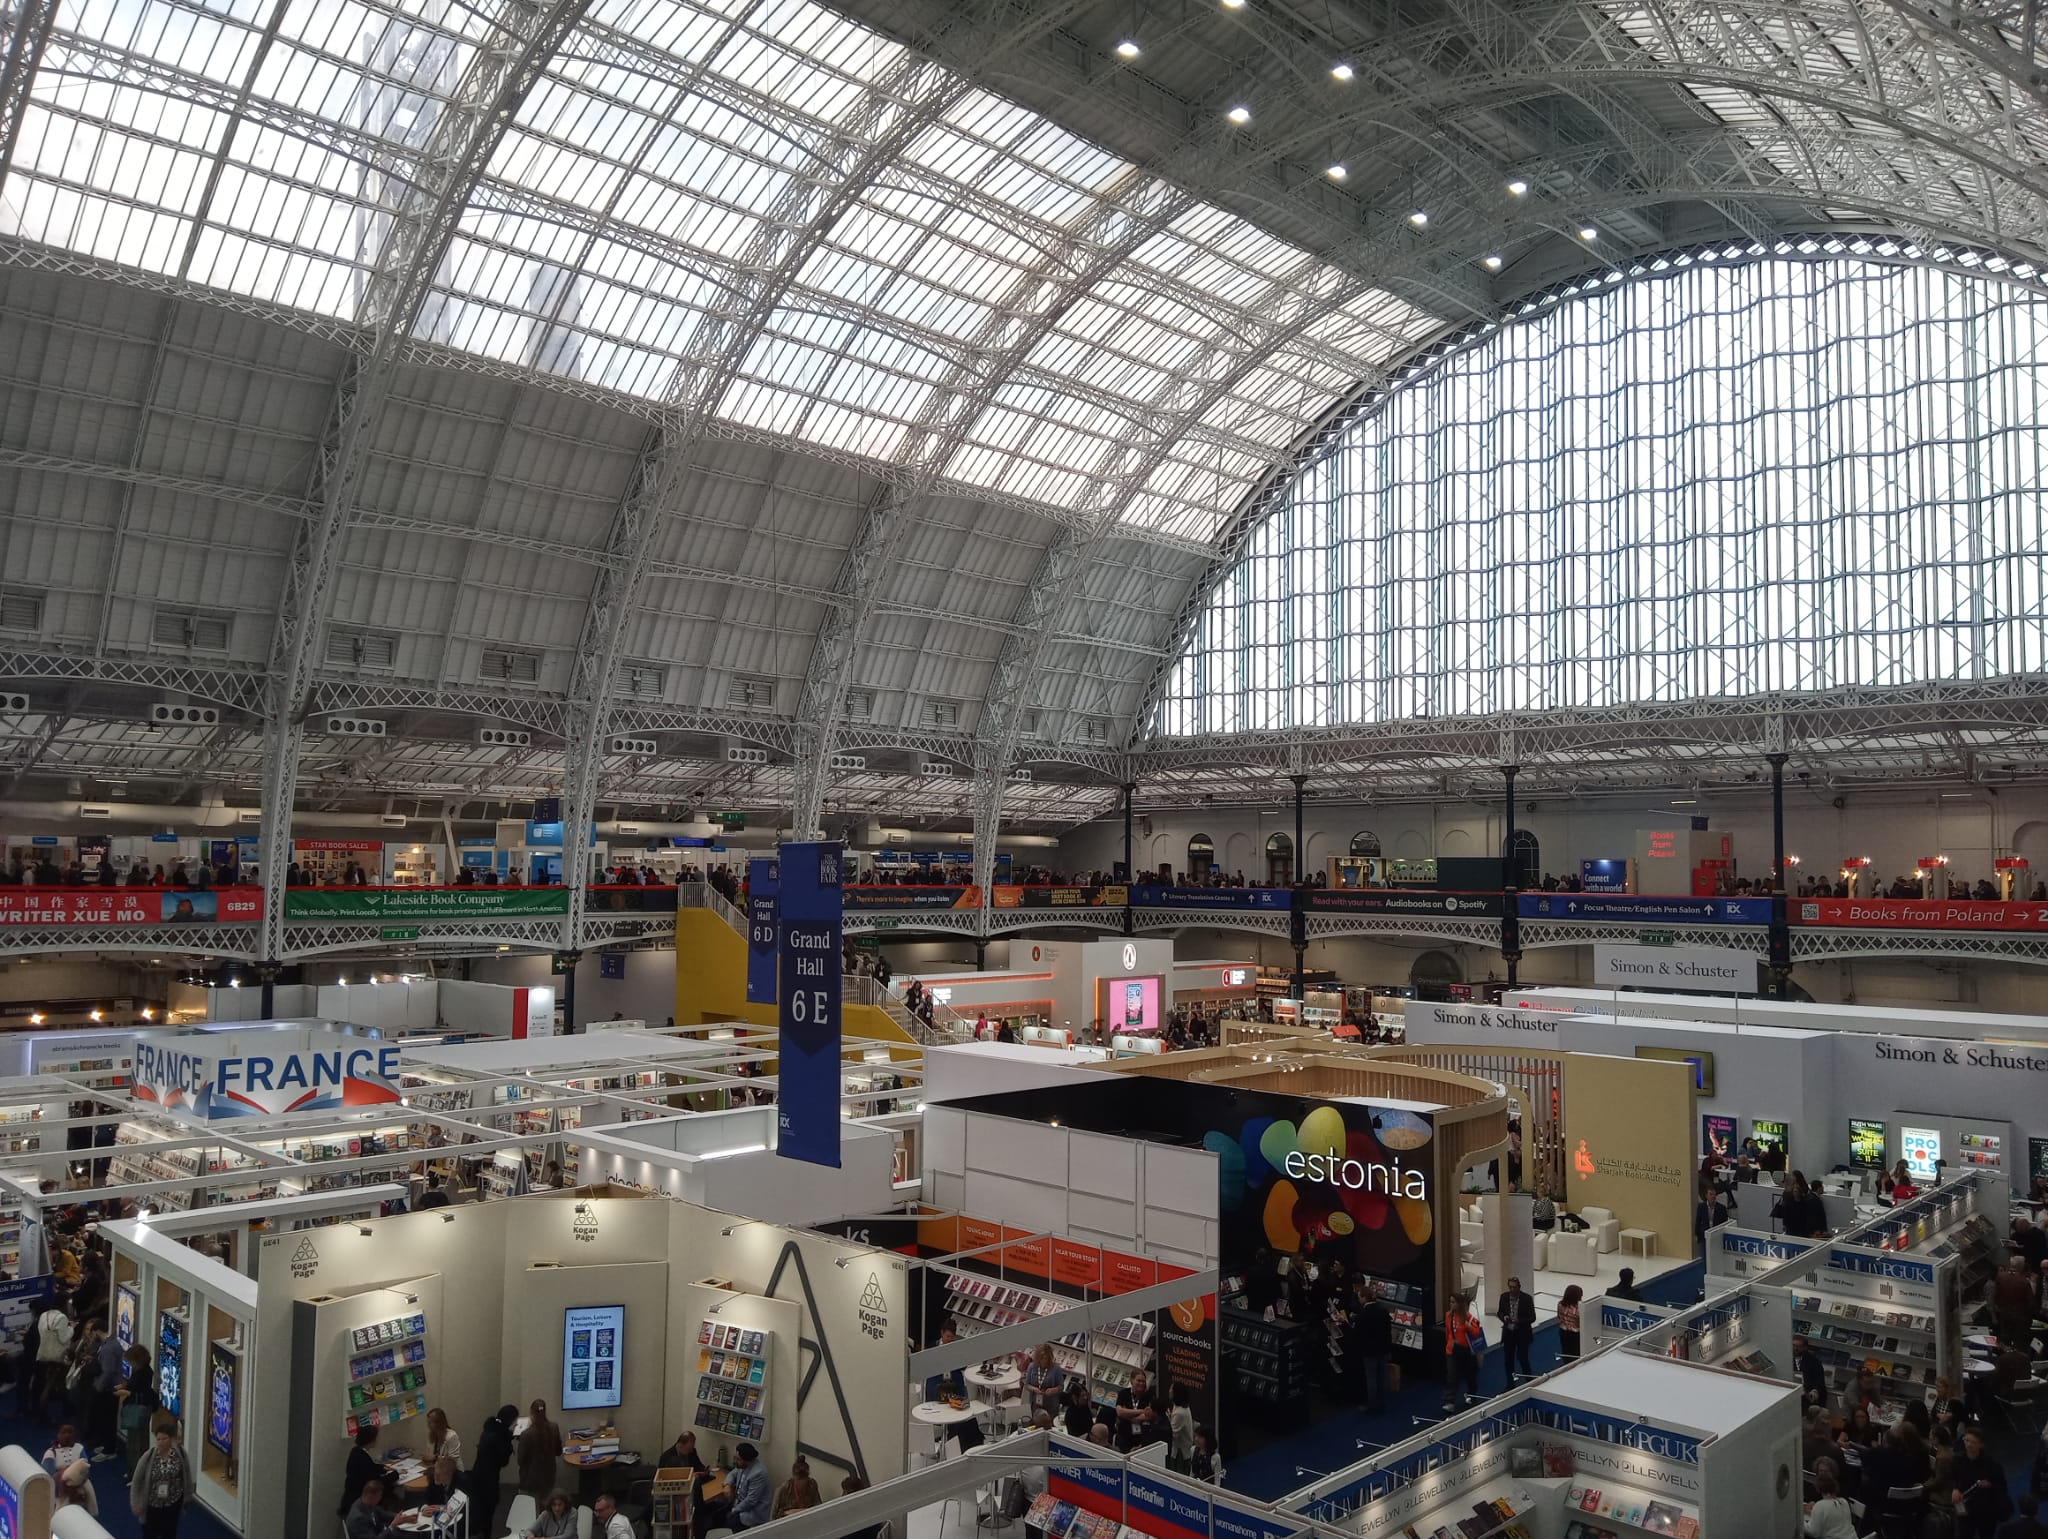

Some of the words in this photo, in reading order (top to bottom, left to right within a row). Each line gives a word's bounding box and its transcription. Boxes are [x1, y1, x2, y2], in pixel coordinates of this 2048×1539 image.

[820, 864, 838, 874] BOOK
[820, 873, 838, 884] FAIR
[1584, 874, 1609, 882] Connect
[1585, 884, 1600, 892] with
[1604, 884, 1622, 892] world
[227, 902, 256, 911] 6B29
[383, 894, 429, 905] Lakeside
[430, 894, 457, 905] Book
[458, 894, 505, 906] Company
[754, 899, 774, 909] Grand
[1312, 897, 1331, 905] Read
[1347, 899, 1364, 907] your
[1385, 899, 1431, 908] Audiobooks
[1458, 900, 1487, 910] Spotify
[453, 907, 477, 915] printing
[1605, 904, 1662, 914] Theatre/English
[1679, 906, 1700, 914] Salon
[1726, 904, 1742, 914] RX
[1850, 907, 1897, 920] Books
[1901, 907, 1940, 921] from
[1946, 909, 2005, 922] Poland
[72, 910, 111, 922] XUE
[116, 910, 146, 922] MO
[757, 911, 771, 921] Hall
[753, 926, 761, 942] 6
[763, 927, 773, 943] D
[790, 930, 831, 949] Grand
[796, 957, 824, 976] Hall
[1610, 958, 1654, 974] Simon
[1658, 961, 1670, 975] &
[1675, 961, 1738, 978] Schuster
[792, 990, 806, 1022] 6
[813, 991, 828, 1025] E
[1434, 1009, 1478, 1027] Simon
[1480, 1011, 1492, 1028] &
[1496, 1013, 1558, 1032] Schuster
[1875, 1041, 1936, 1063] Simon
[1943, 1047, 1959, 1065] &
[135, 1043, 203, 1095] FRANCE
[217, 1047, 401, 1094] FRANCE
[1756, 1122, 1783, 1133] GREAT
[1860, 1129, 1875, 1137] THE
[1905, 1137, 1937, 1149] PRO
[1857, 1148, 1879, 1156] SUITE
[1285, 1146, 1425, 1200] estonia
[1907, 1160, 1936, 1173] OLS
[1625, 1168, 1645, 1180] Book
[1645, 1171, 1681, 1187] Authority
[572, 1226, 598, 1236] Kogan
[575, 1232, 595, 1242] Page
[1055, 1248, 1068, 1256] HEAR
[1069, 1251, 1082, 1259] YOUR
[1082, 1254, 1098, 1263] STORY
[1736, 1239, 1780, 1259] PGUK
[290, 1261, 319, 1271] Kogan
[1116, 1262, 1142, 1273] CALLISTO
[1881, 1261, 1928, 1281] PGUK
[293, 1269, 316, 1279] Page
[858, 1309, 888, 1327] Kogan
[861, 1322, 885, 1340] Page
[1162, 1331, 1212, 1350] sourcebooks
[1172, 1346, 1201, 1359] LEADING
[1168, 1364, 1206, 1381] PUBLISHING
[1637, 1430, 1698, 1464] PGUK
[1410, 1478, 1456, 1507] LLEWELLYN
[1463, 1451, 1506, 1480] LLEWELLYN
[1169, 1499, 1209, 1524] Decanter
